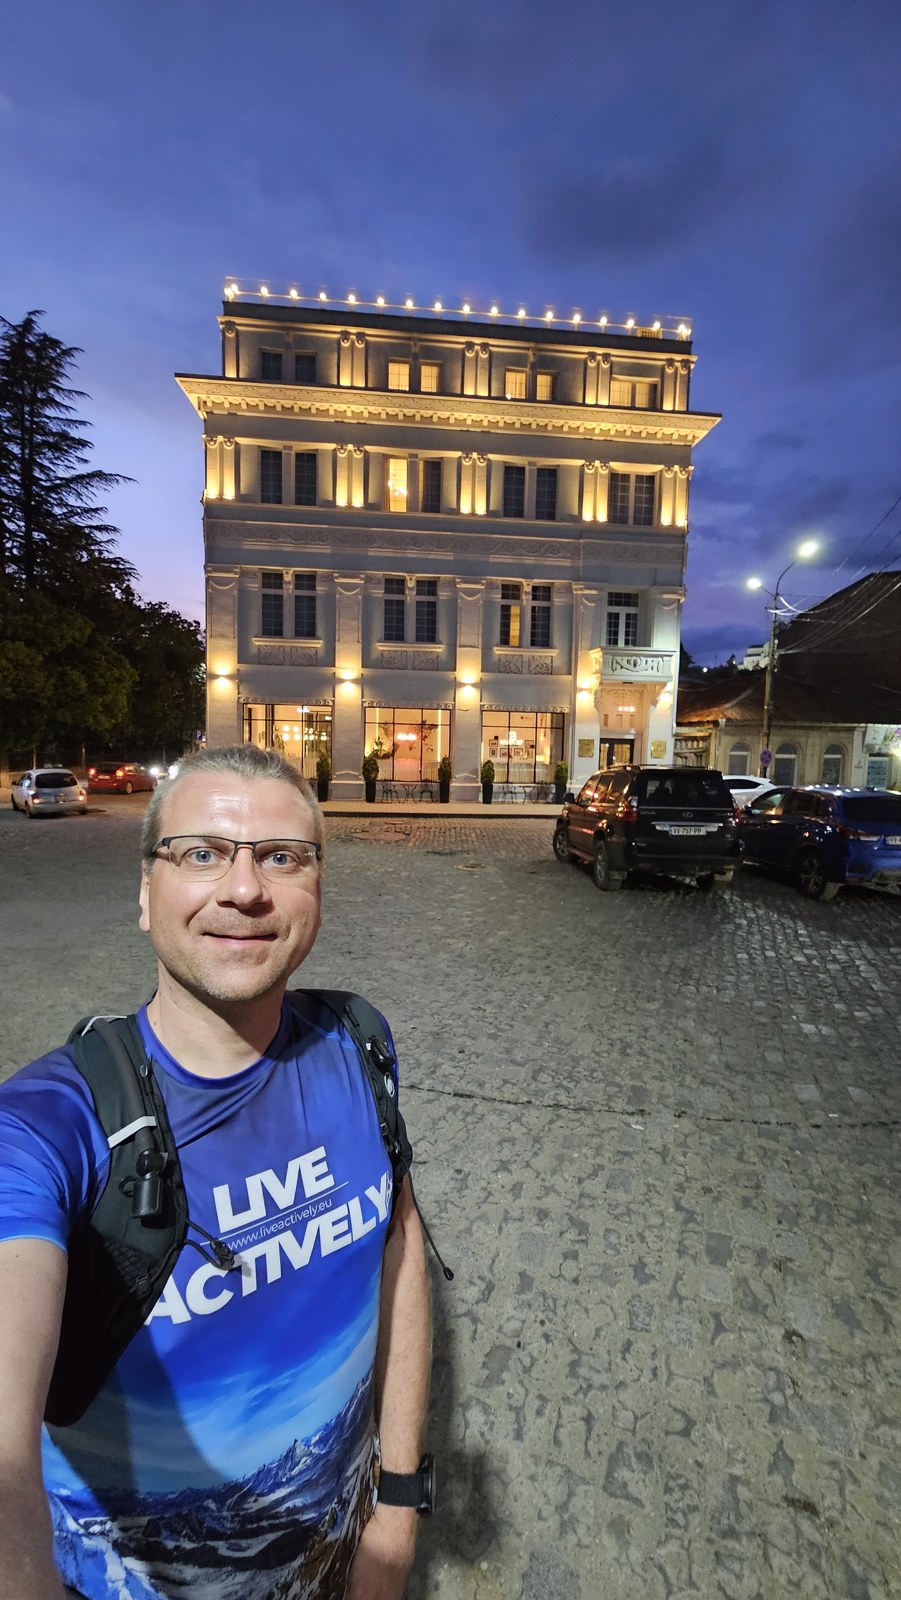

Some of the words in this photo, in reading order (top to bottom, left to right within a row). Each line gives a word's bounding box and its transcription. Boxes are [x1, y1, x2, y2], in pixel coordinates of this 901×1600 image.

[213, 1145, 335, 1233] LIVE
[227, 1198, 332, 1251] www.liveactively.eu
[144, 1172, 388, 1326] ACTIVELY
